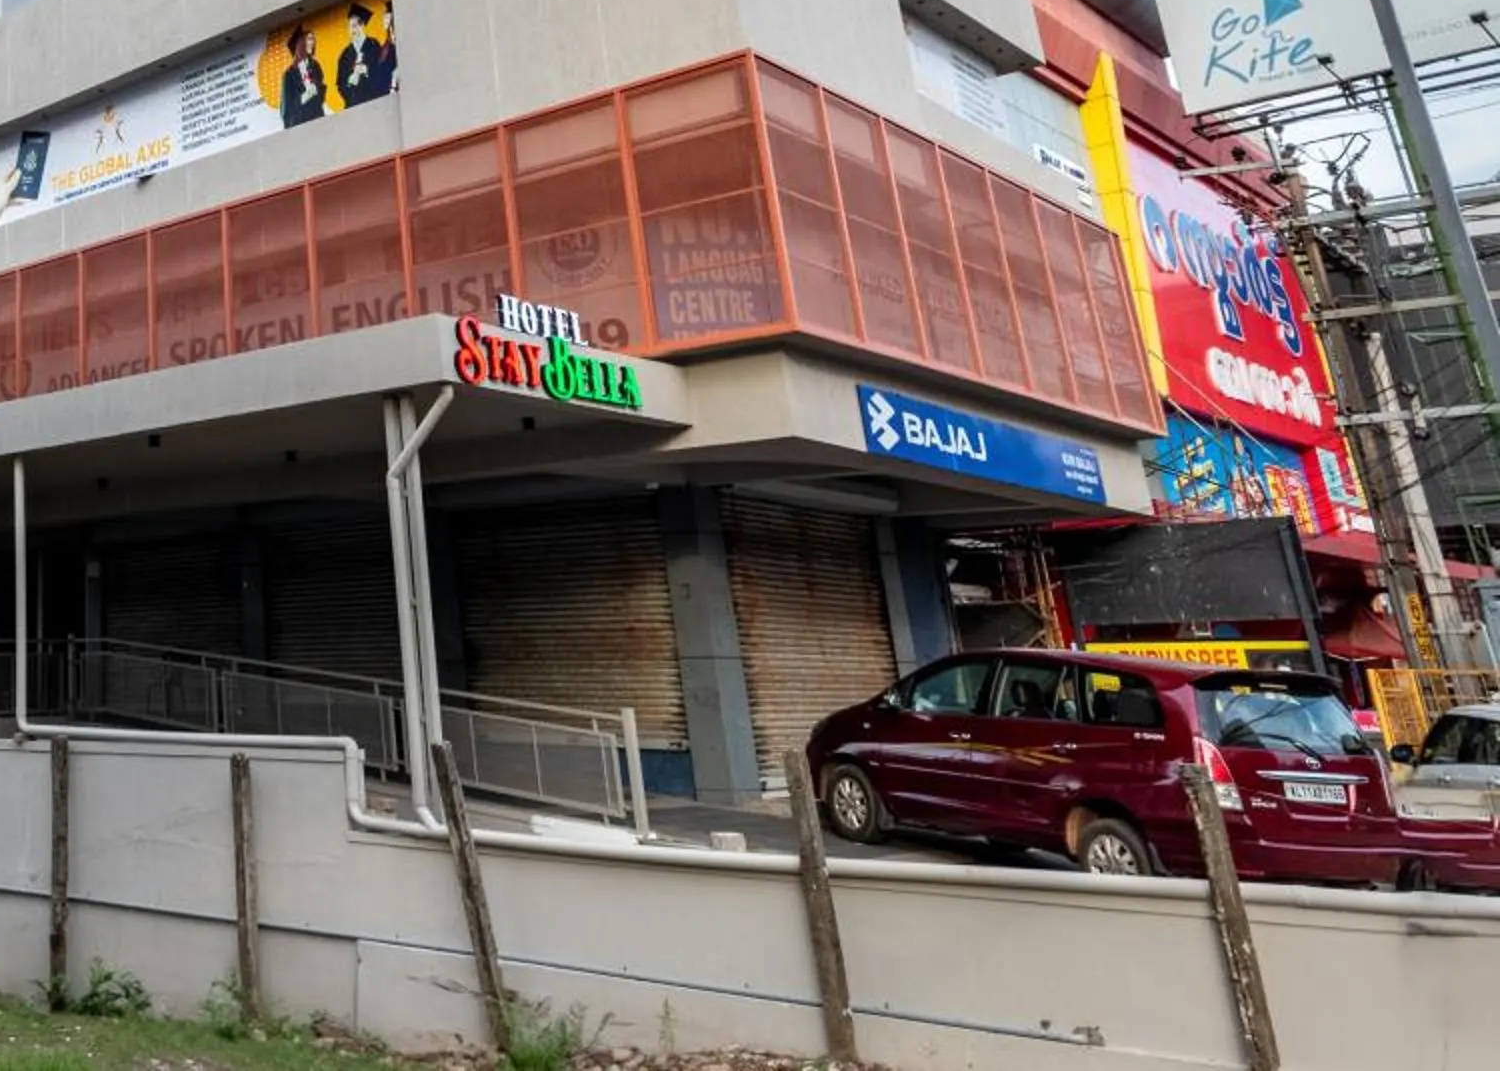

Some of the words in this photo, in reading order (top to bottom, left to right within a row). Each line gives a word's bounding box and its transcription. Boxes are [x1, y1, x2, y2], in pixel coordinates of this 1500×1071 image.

[1211, 6, 1261, 43] Go
[1203, 36, 1316, 88] Kite
[52, 173, 75, 191] THE
[78, 153, 133, 185] GLOBAL
[137, 136, 172, 163] AXIS
[498, 292, 589, 345] HOTEL
[668, 289, 757, 324] CENTRE
[169, 314, 305, 367] SPOKEN
[454, 314, 544, 386] STAY
[539, 334, 644, 410] BELLA
[902, 411, 987, 462] BAJAJ
